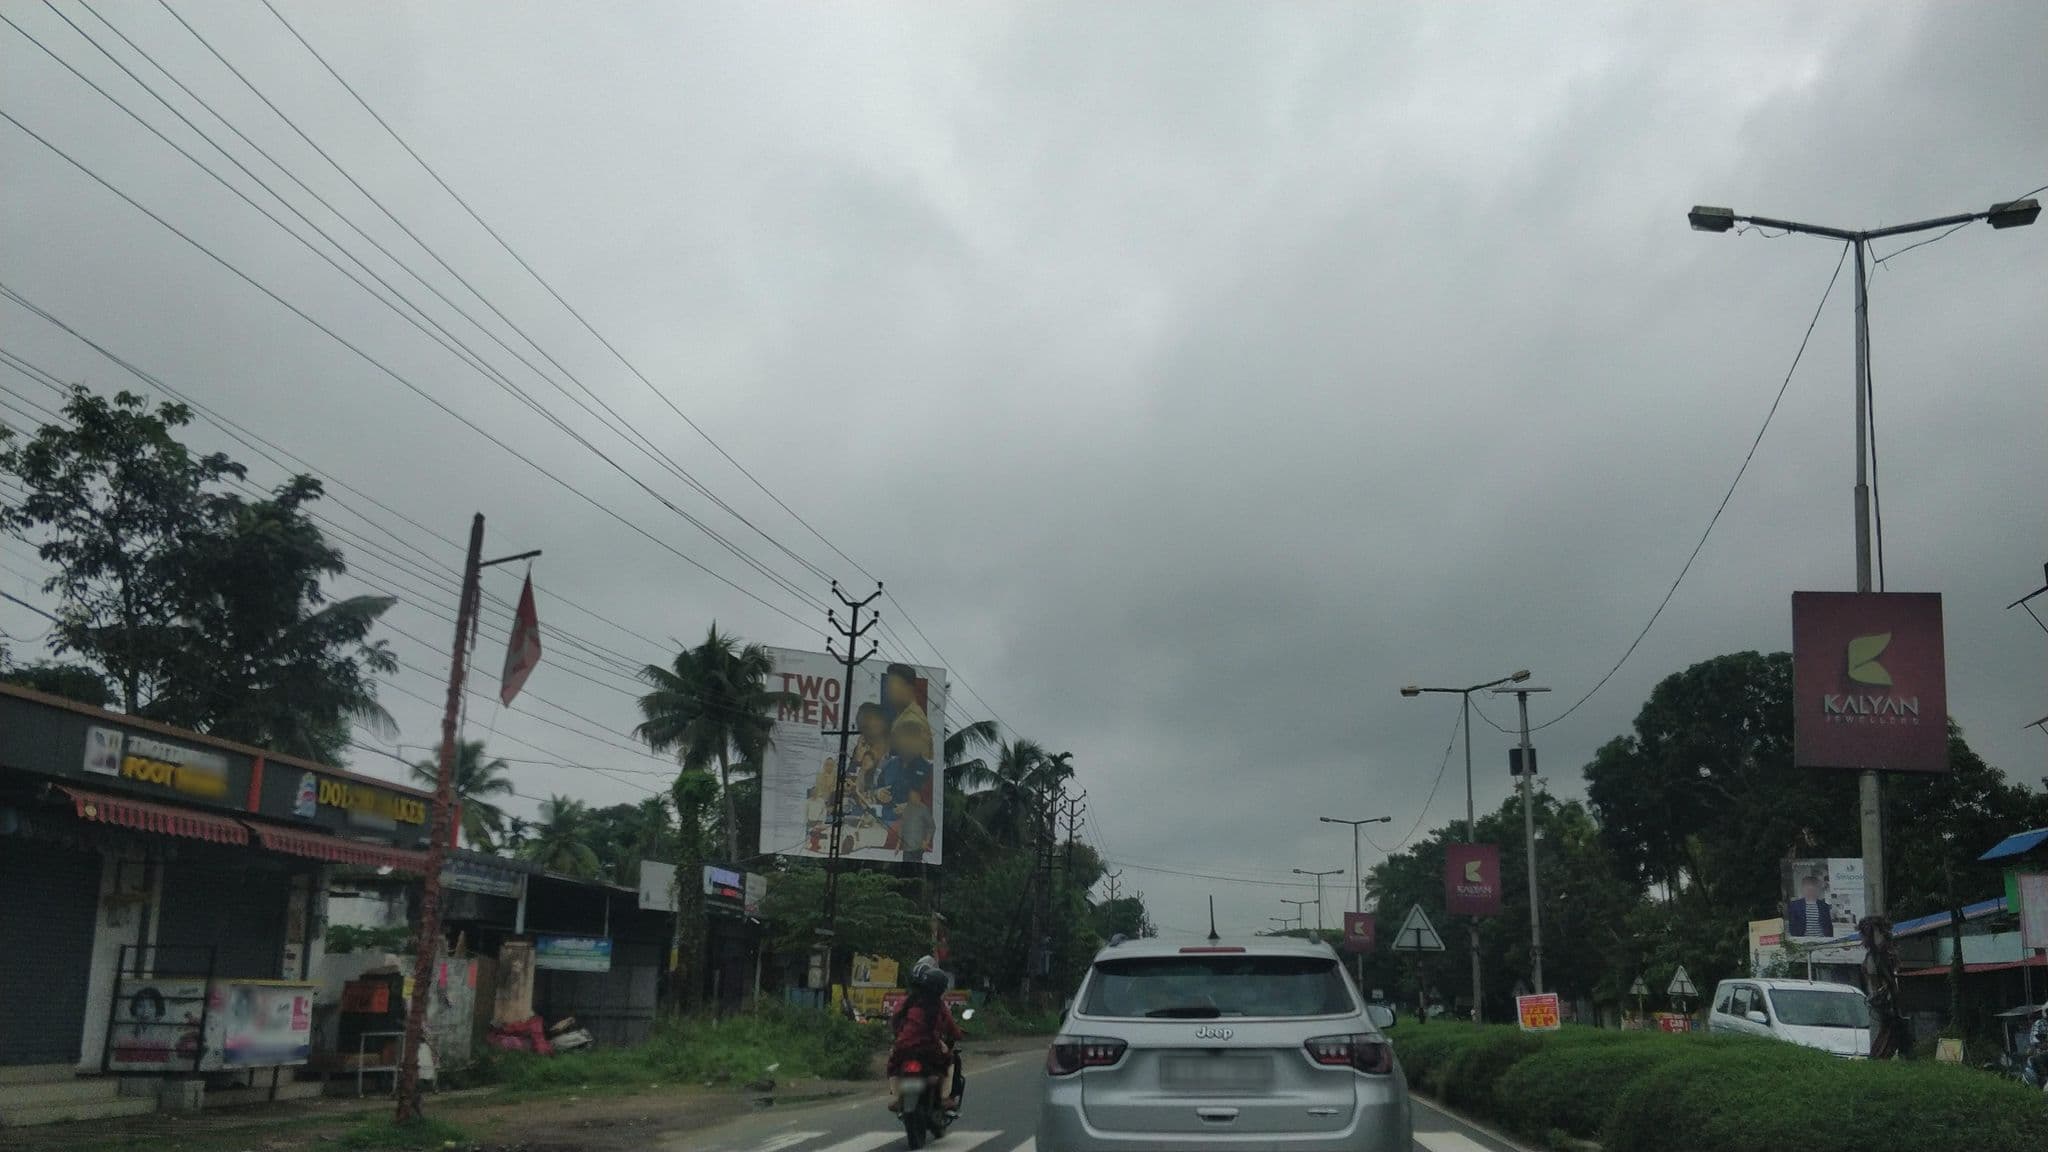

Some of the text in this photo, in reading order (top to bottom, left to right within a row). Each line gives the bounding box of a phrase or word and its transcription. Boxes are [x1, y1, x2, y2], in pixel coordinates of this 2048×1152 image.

[783, 672, 841, 703] TWO
[777, 698, 840, 730] MEN
[1824, 694, 1919, 716] KALYAN
[1195, 1025, 1234, 1041] Jeep
